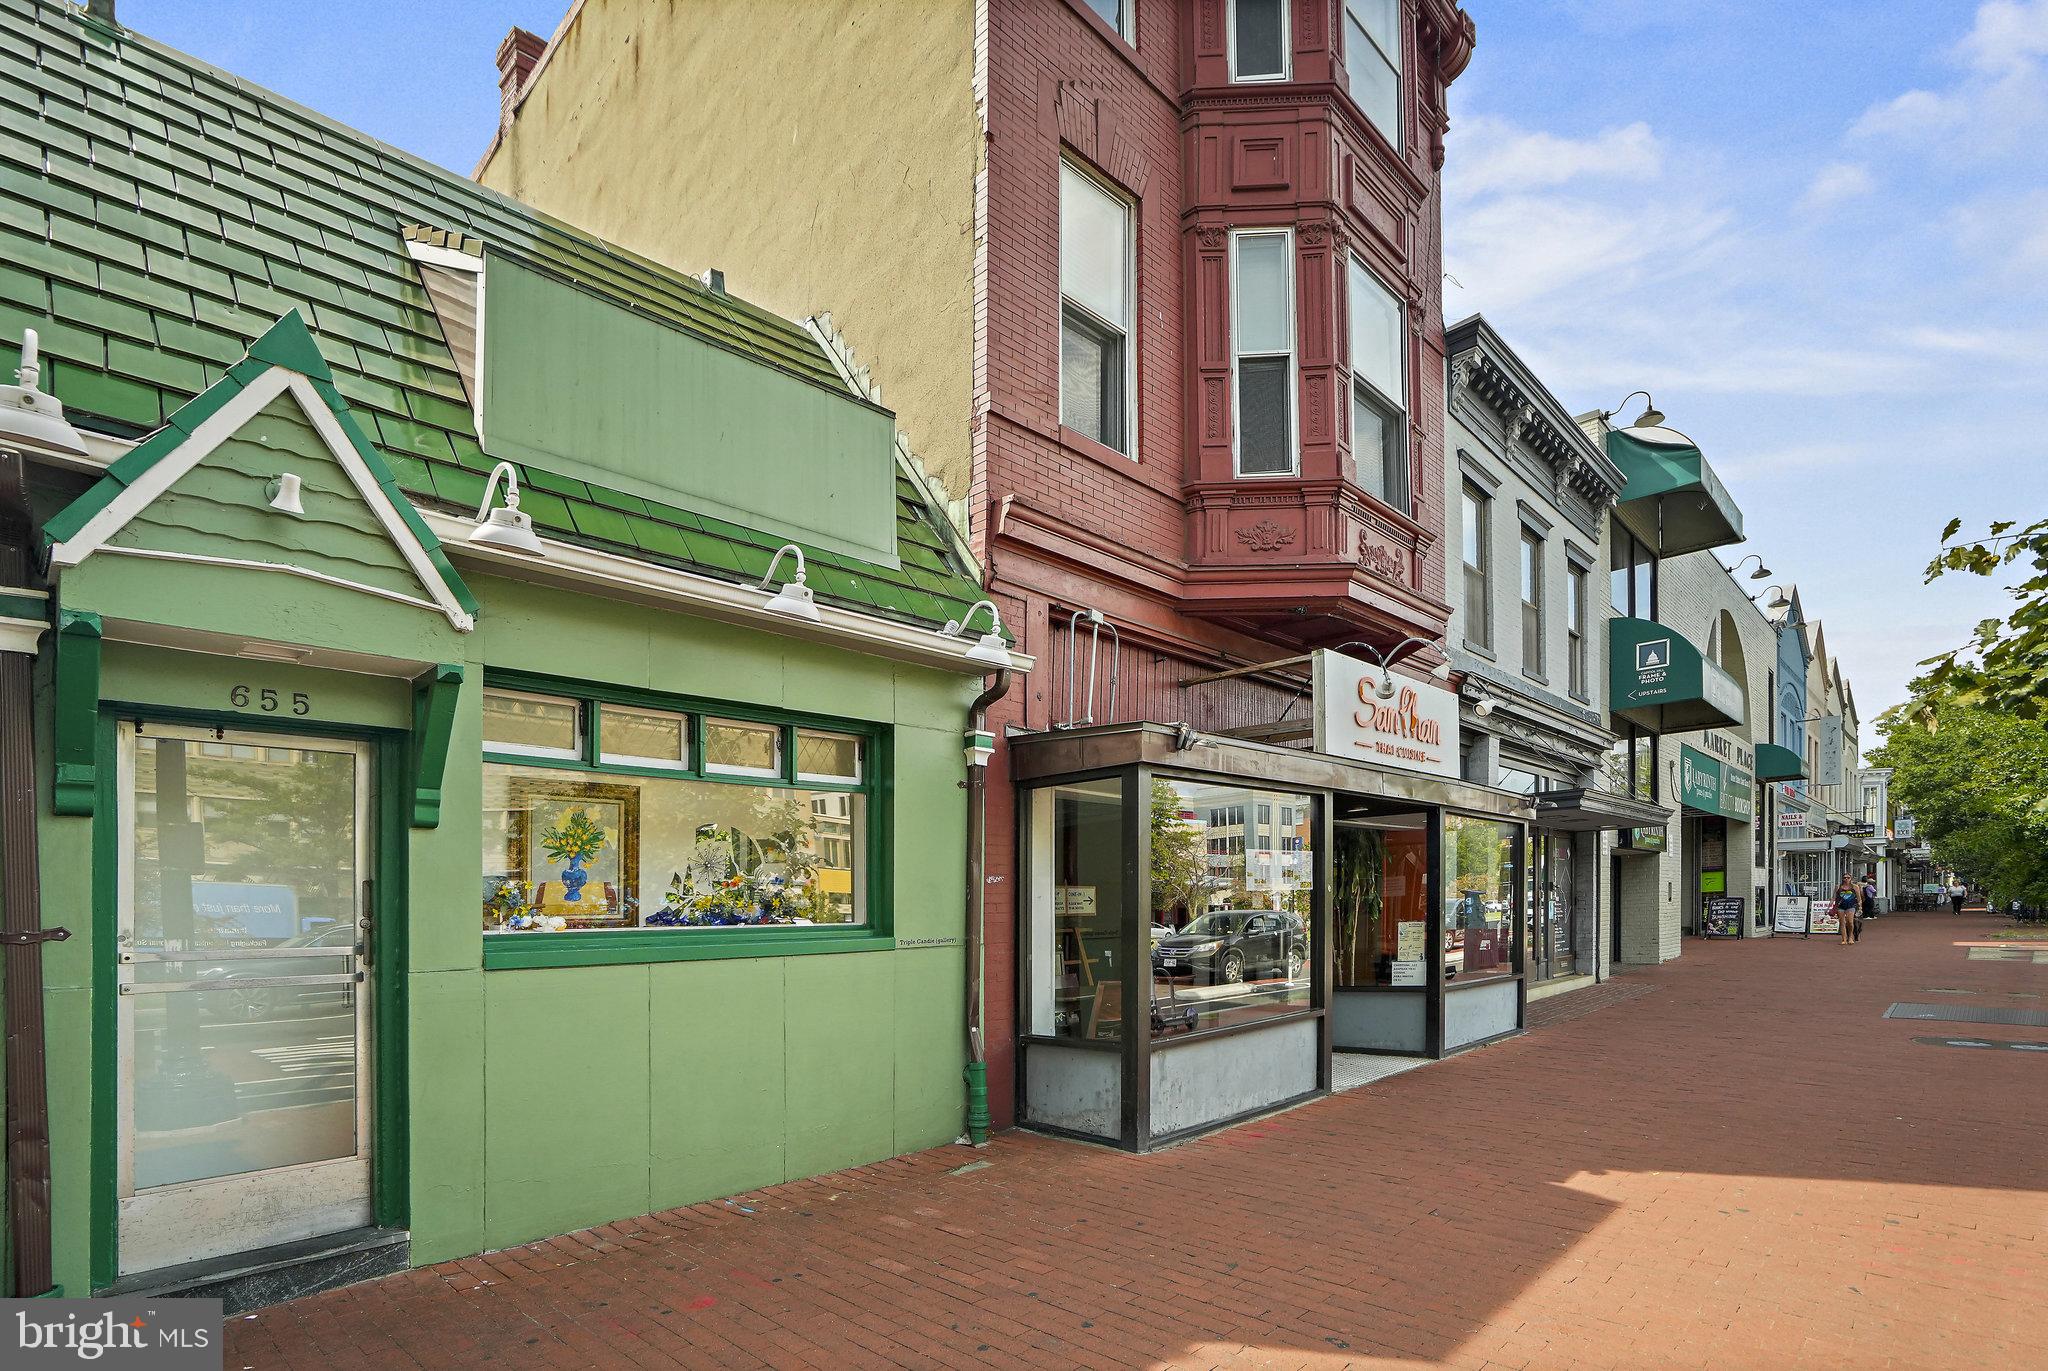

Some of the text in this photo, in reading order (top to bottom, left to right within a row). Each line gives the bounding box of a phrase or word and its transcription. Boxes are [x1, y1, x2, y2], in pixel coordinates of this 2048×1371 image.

[1638, 672, 1661, 680] FRAME
[1640, 676, 1665, 684] PHOTO
[231, 685, 310, 715] 655
[1638, 688, 1667, 697] UPSTAIRS
[1375, 741, 1426, 763] THAI CUISINE
[1703, 729, 1753, 770] MARKET PLACE
